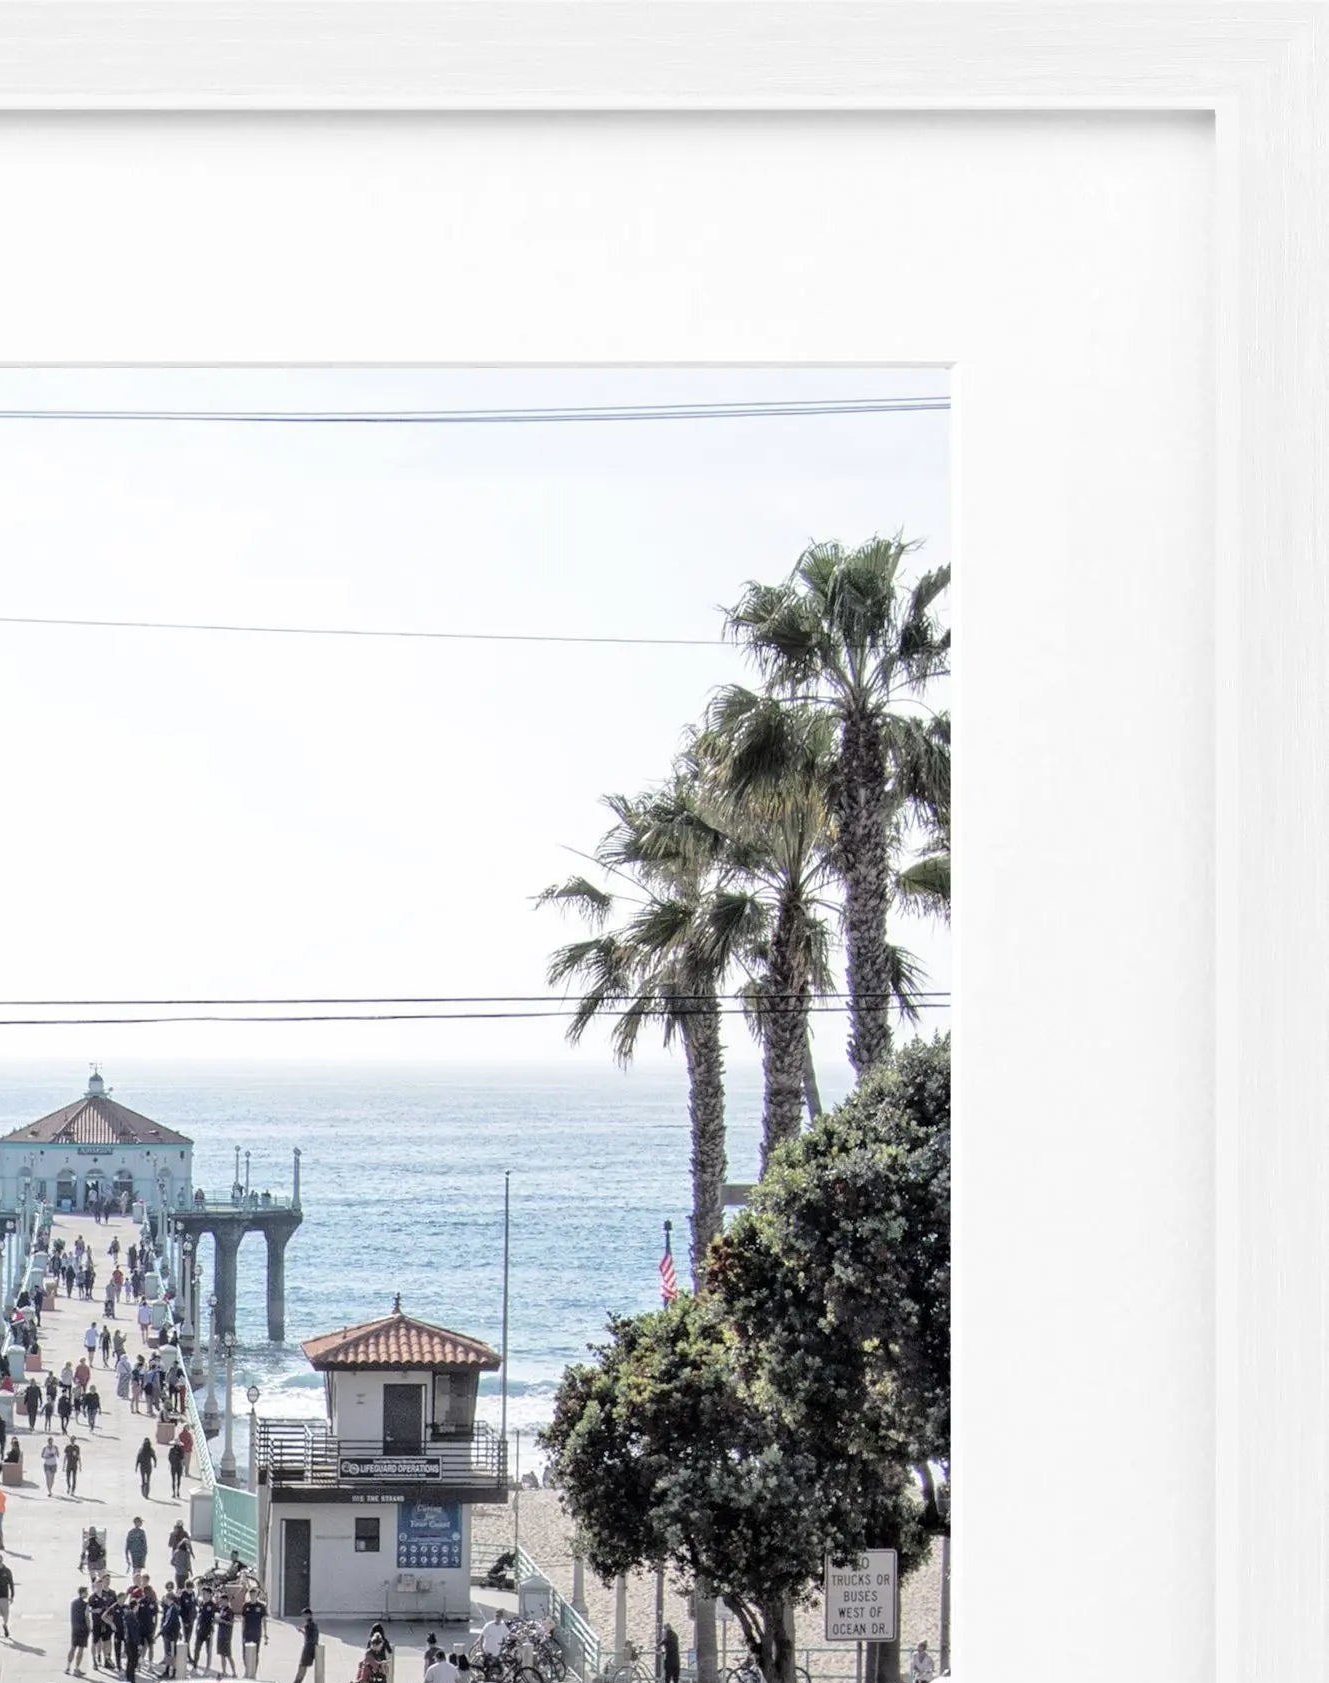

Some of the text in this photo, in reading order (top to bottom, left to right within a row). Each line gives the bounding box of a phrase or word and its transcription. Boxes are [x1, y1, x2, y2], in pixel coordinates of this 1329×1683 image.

[360, 1464, 439, 1473] LIFEGUARD OPERATIONS
[832, 1573, 890, 1586] TRUCKS OR
[843, 1590, 878, 1602] BUSES
[838, 1606, 883, 1618] WEST OF
[832, 1623, 888, 1635] OCEAN DR.
